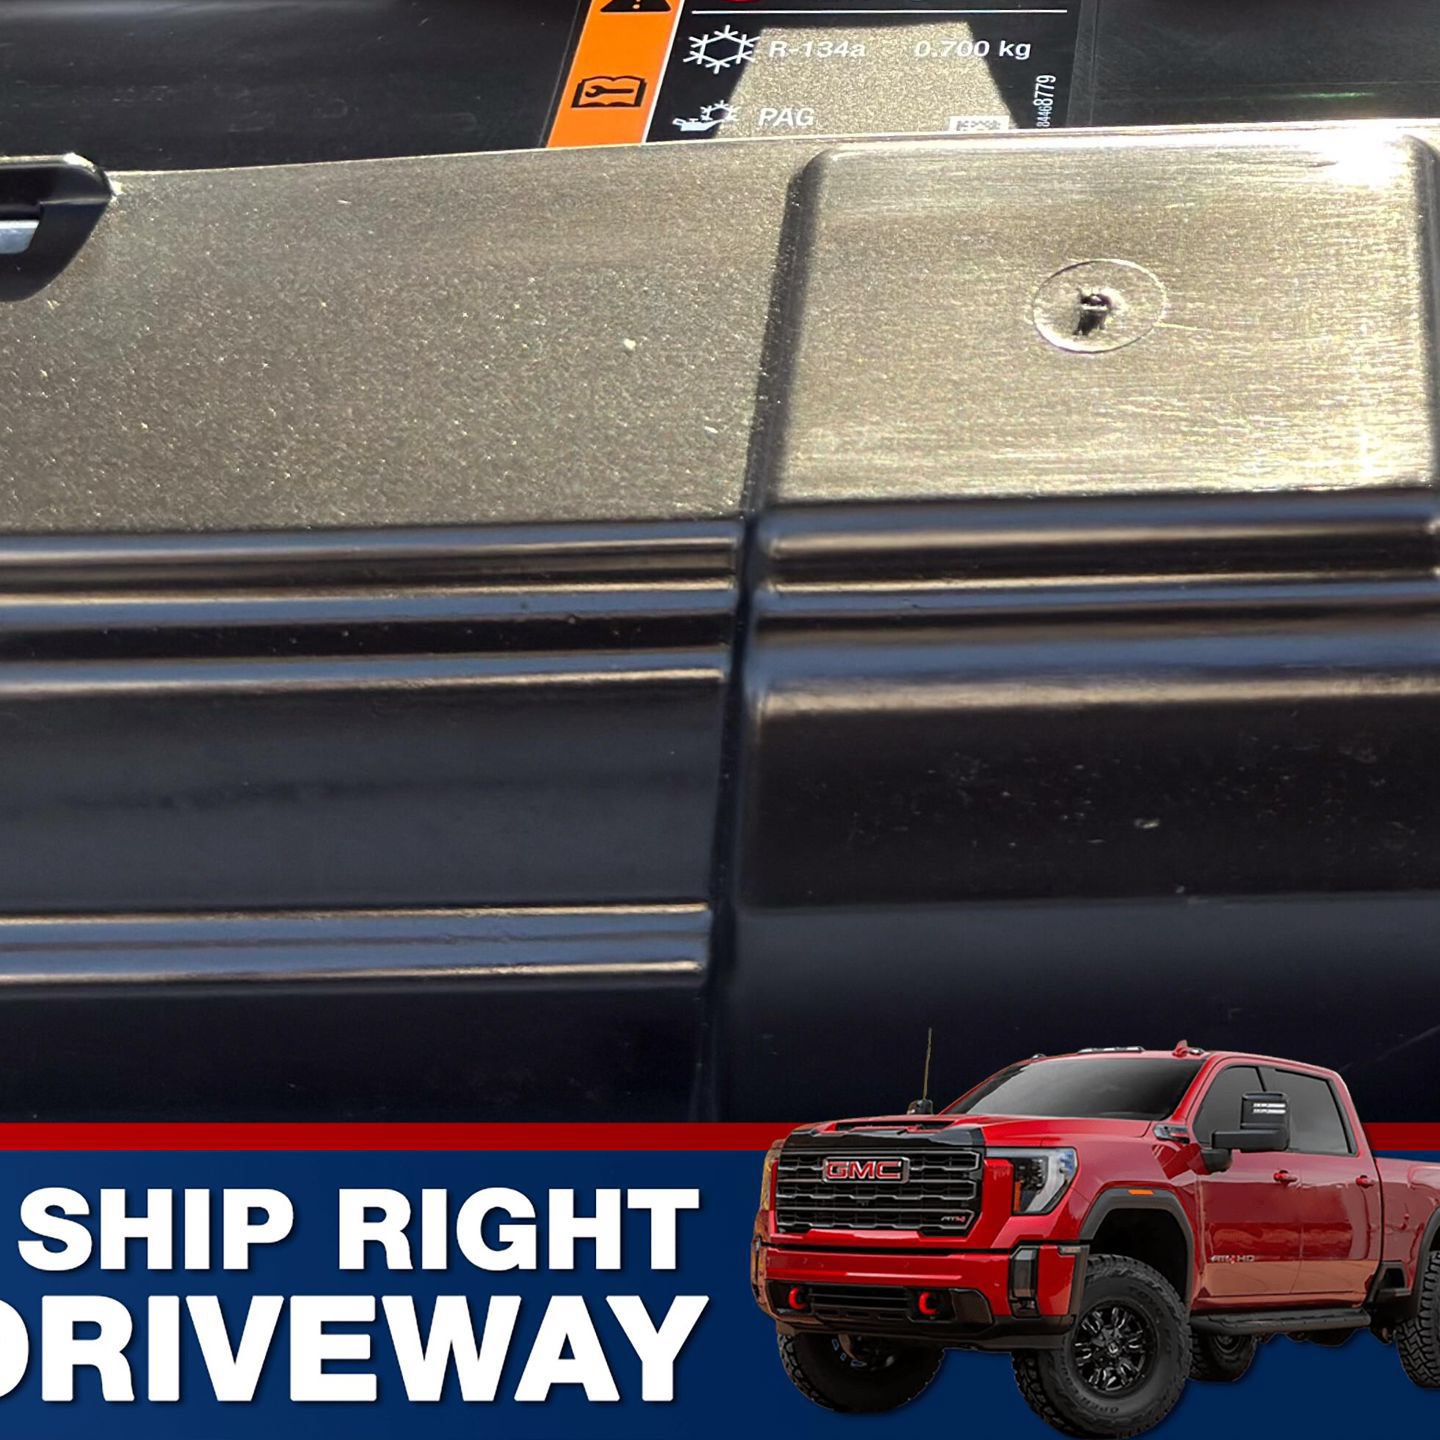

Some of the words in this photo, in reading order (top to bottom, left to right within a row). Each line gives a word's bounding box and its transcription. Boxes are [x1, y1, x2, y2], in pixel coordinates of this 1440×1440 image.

[768, 40, 866, 58] R-134a
[913, 39, 990, 58] 0.700
[998, 39, 1031, 60] kg
[1032, 74, 1057, 128] 84468779
[760, 106, 815, 127] PAG
